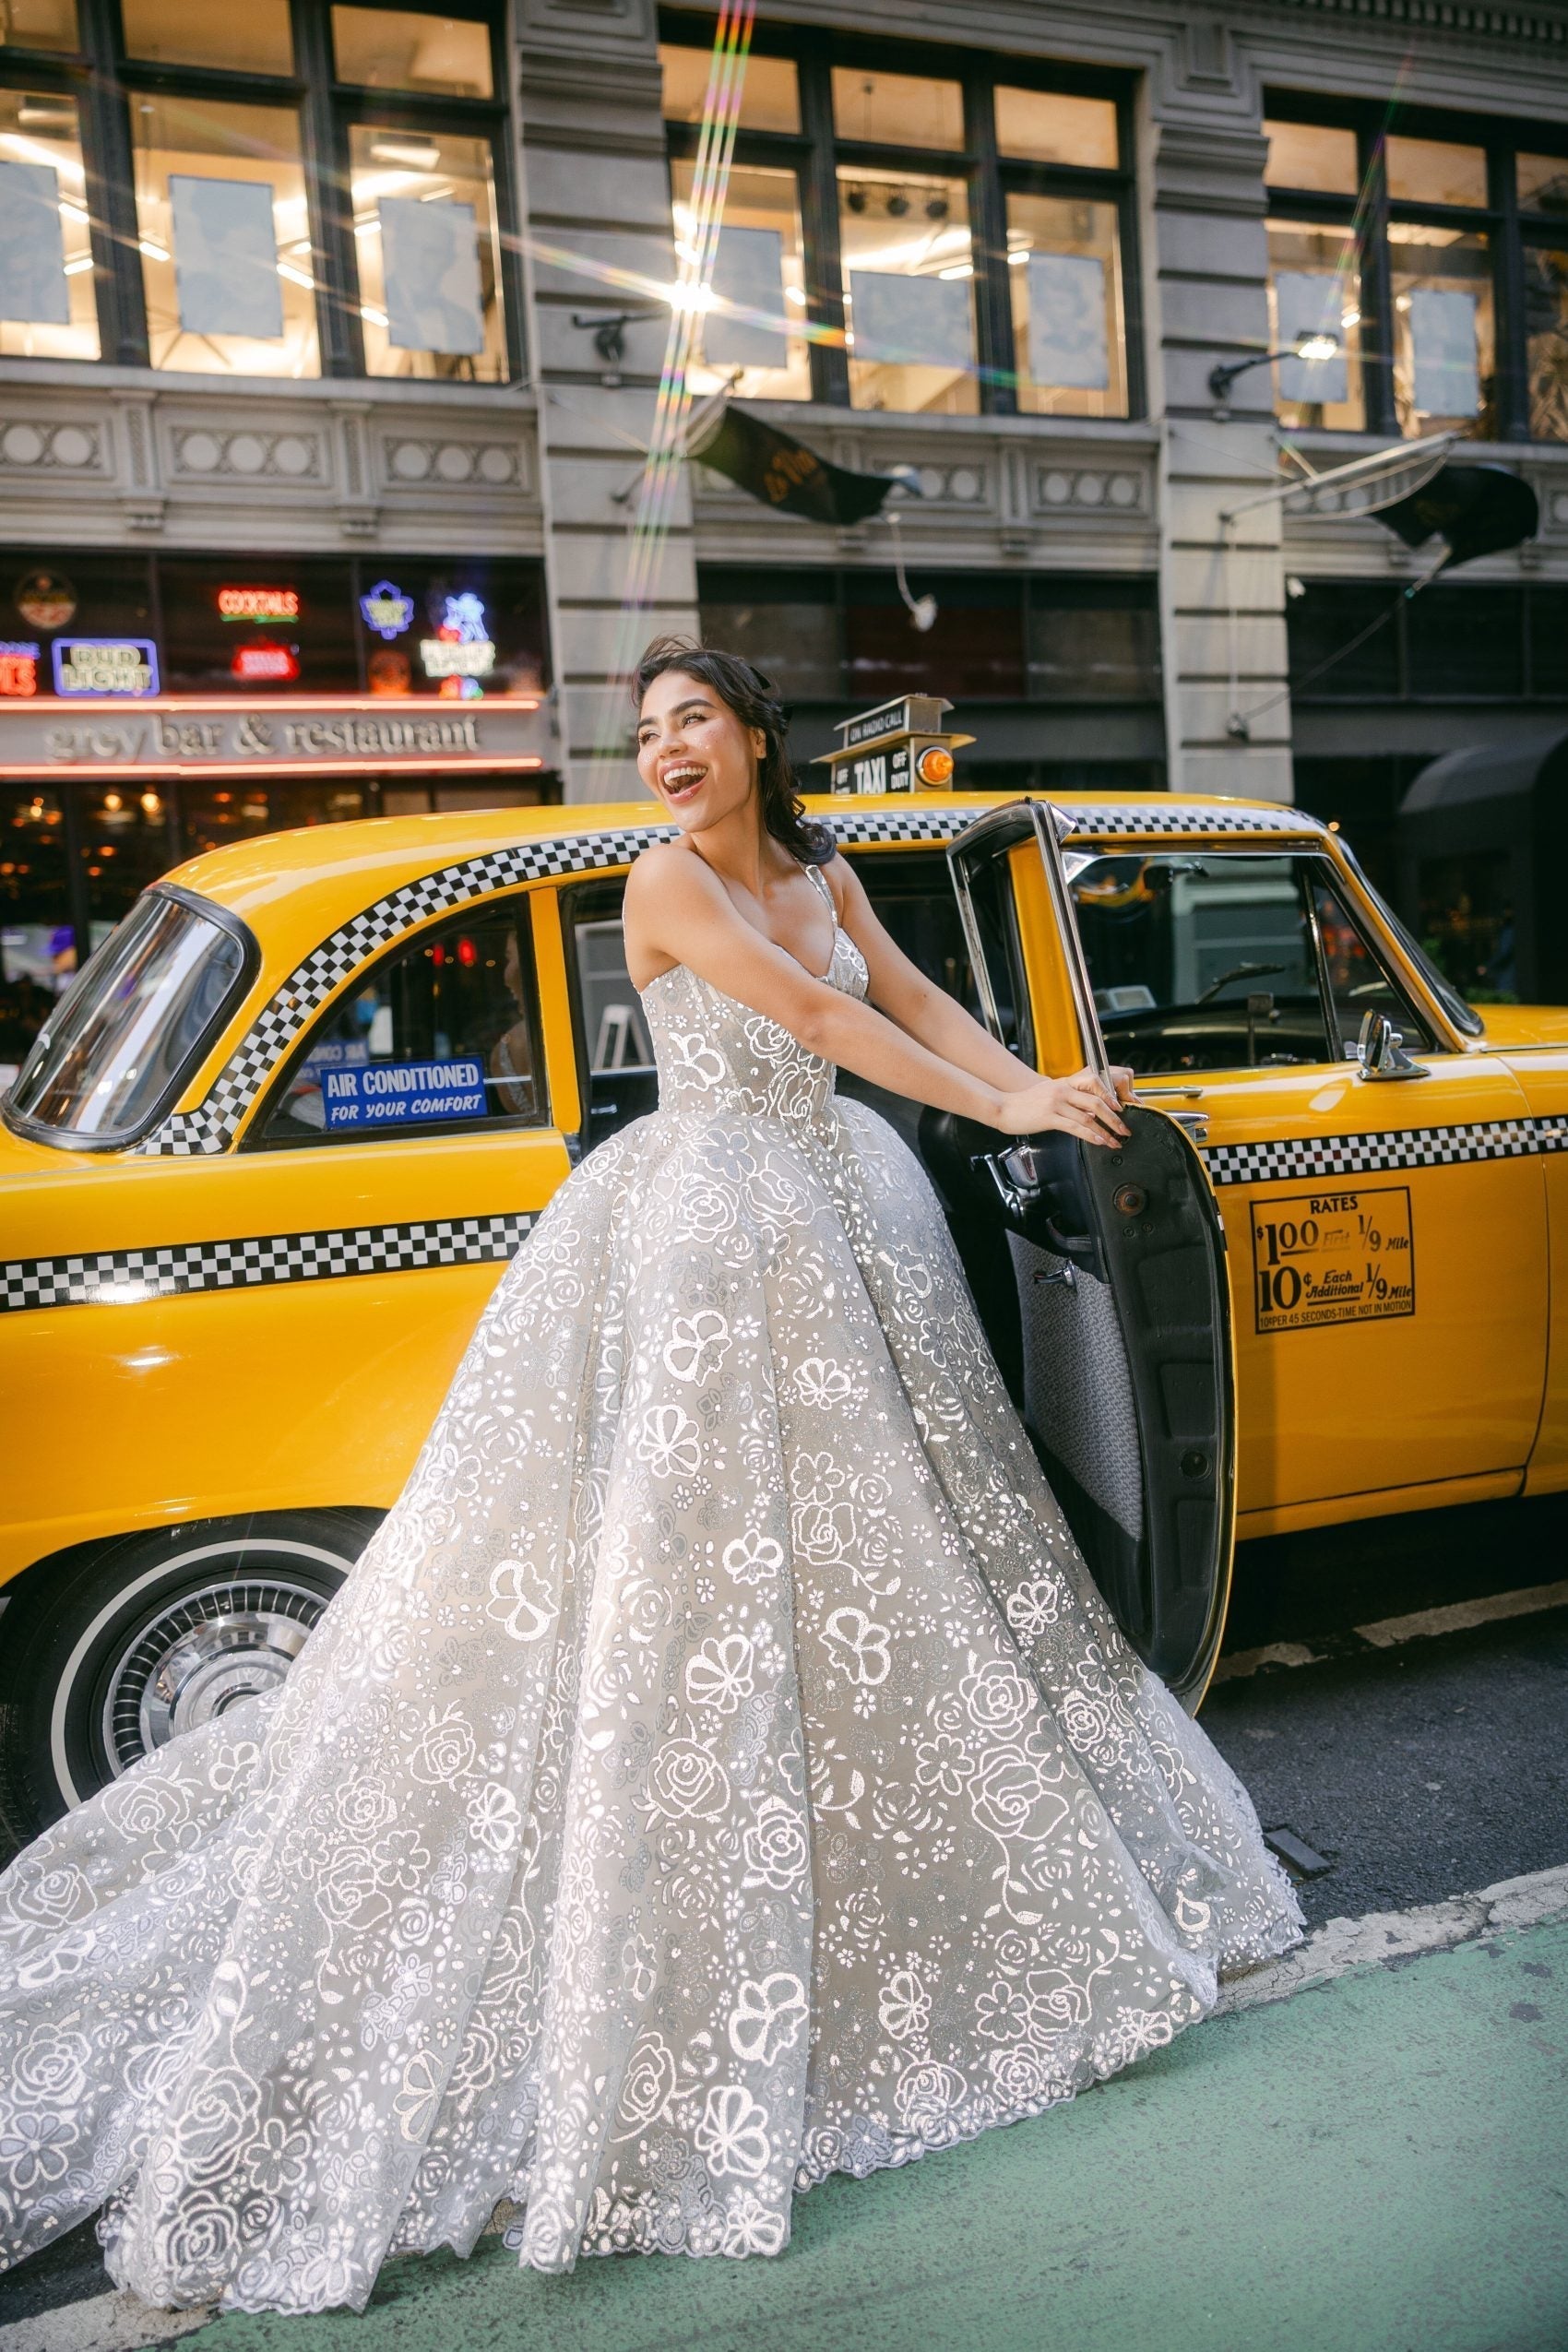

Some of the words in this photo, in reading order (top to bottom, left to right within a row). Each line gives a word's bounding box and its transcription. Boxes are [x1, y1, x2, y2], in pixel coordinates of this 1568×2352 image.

[69, 643, 141, 670] BUD
[59, 663, 153, 692] LIGHT
[43, 724, 147, 765] grey
[152, 714, 221, 756] bar
[232, 713, 276, 756] &
[283, 715, 481, 754] restaurant
[891, 751, 908, 769] OFF
[837, 767, 849, 785] OFF
[854, 755, 886, 794] TAXI
[890, 771, 909, 790] DUTY
[327, 1073, 359, 1098] AIR
[362, 1063, 480, 1095] CONDITIONED
[331, 1106, 359, 1122] FOR
[365, 1101, 407, 1119] YOUR
[411, 1094, 482, 1114] COMFORT
[1310, 1196, 1359, 1215] RATES
[1385, 1237, 1409, 1251] Mile
[1324, 1269, 1352, 1284] Each
[1305, 1281, 1364, 1299] Additional
[1387, 1285, 1411, 1300] Mile
[1289, 1313, 1300, 1324] 45
[1358, 1303, 1372, 1315] NOT
[1374, 1302, 1383, 1314] IN
[1384, 1300, 1411, 1313] MOTION
